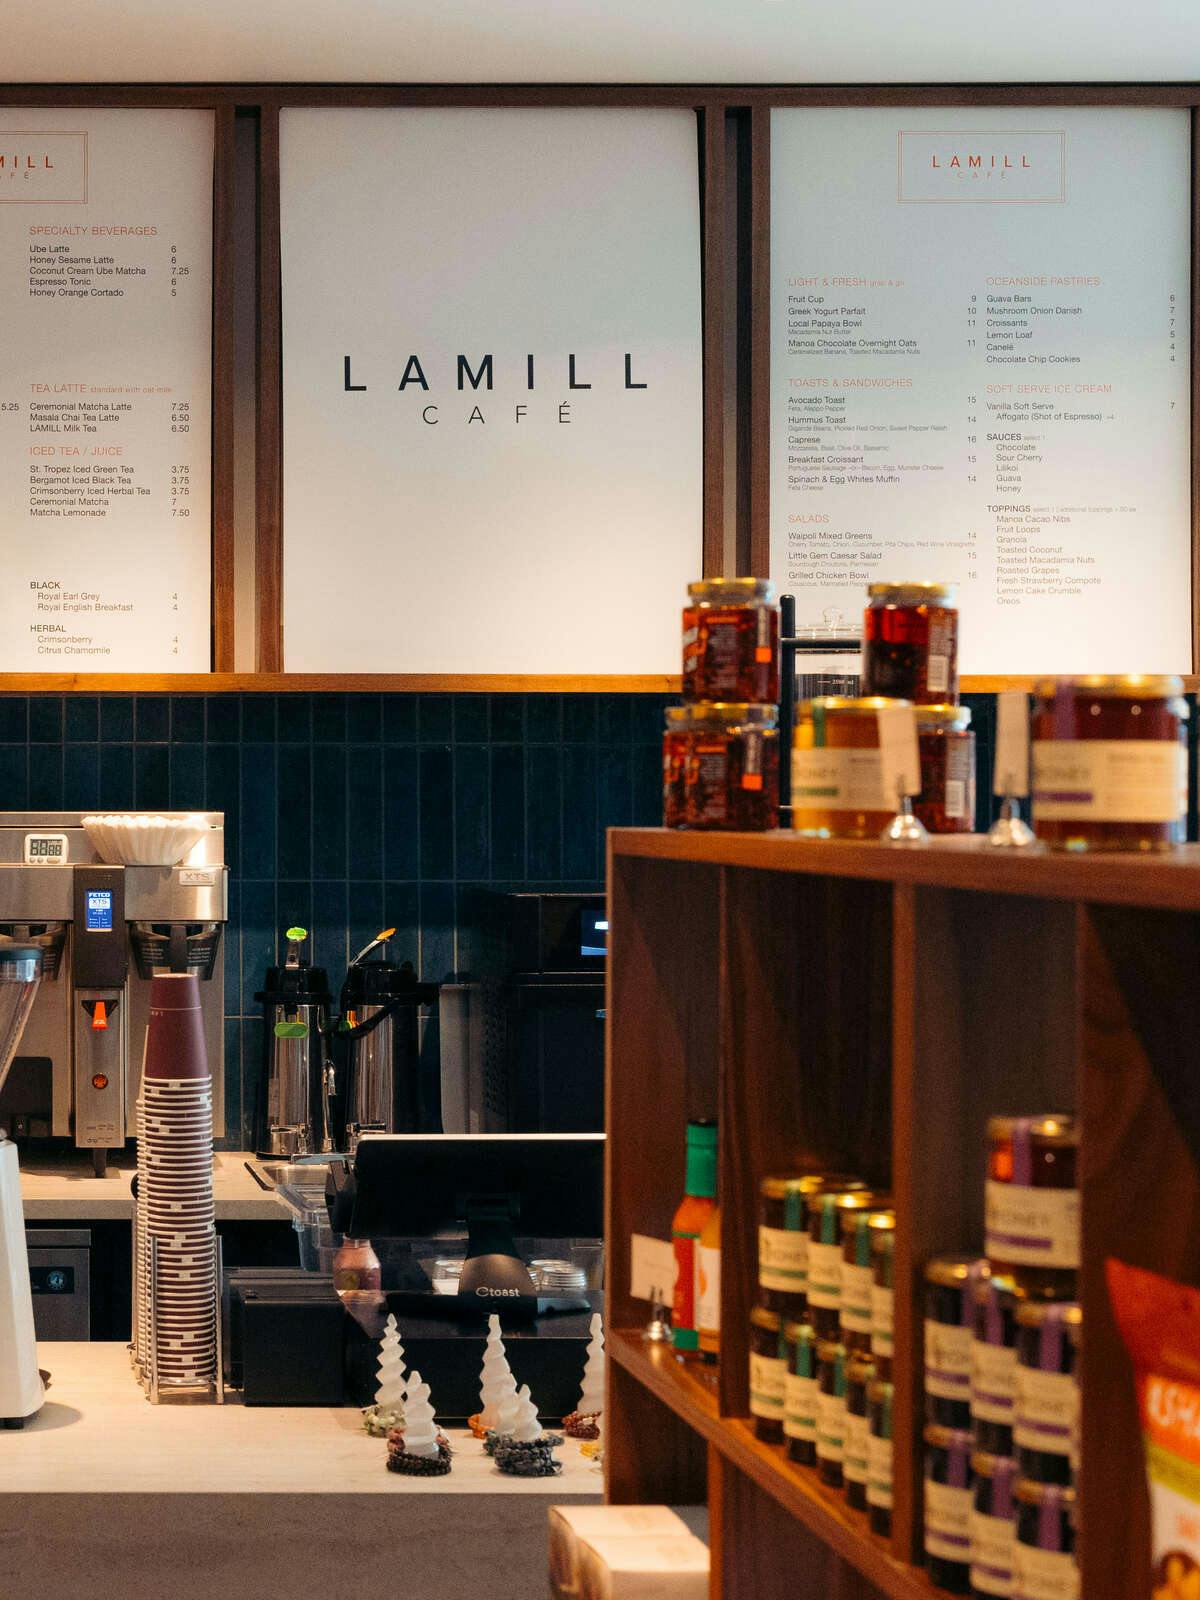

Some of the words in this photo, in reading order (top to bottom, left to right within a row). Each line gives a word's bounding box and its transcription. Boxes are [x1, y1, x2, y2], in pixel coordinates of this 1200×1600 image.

[932, 155, 1031, 168] LAMILL
[30, 226, 88, 235] SPECIALTY
[92, 226, 158, 236] BEVERAGES
[30, 245, 47, 253] Ube
[49, 245, 70, 253] Latte
[171, 245, 177, 253] 6
[30, 256, 56, 266] Honey
[58, 256, 91, 264] Sesame
[94, 256, 114, 264] Latte
[30, 267, 65, 275] Coconut
[67, 267, 94, 275] Cream
[96, 267, 113, 275] Ube
[116, 267, 146, 275] Matcha
[172, 267, 190, 275] 7.25
[30, 277, 68, 287] Espresso
[69, 278, 91, 286] Tonic
[171, 278, 177, 286] 6
[986, 277, 1047, 286] OCEANSIDE
[1051, 277, 1100, 286] PASTRIES
[30, 288, 56, 298] Honey
[58, 288, 89, 298] Orange
[91, 289, 124, 297] Cortado
[172, 289, 177, 297] 5
[788, 296, 806, 304] Fruit
[807, 296, 824, 304] Cup
[788, 307, 812, 315] Greek
[813, 308, 839, 317] Yogurt
[841, 307, 866, 315] Parfait
[811, 320, 841, 329] Papaya
[986, 319, 1028, 327] Croissants
[986, 331, 1013, 339] Lemon
[1016, 331, 1033, 339] Loaf
[1170, 330, 1176, 338] 5
[344, 353, 647, 391] LAMILL
[30, 384, 52, 393] TEA
[54, 384, 88, 393] LATTE
[788, 396, 823, 405] Avocado
[824, 396, 845, 404] Toast
[968, 396, 976, 404] 15
[1, 403, 19, 411] 5.25
[30, 402, 76, 411] Ceremonial
[78, 403, 109, 411] Matcha
[111, 403, 132, 411] Latte
[172, 403, 190, 411] 7.25
[986, 402, 1012, 411] Vanilla
[1013, 402, 1030, 410] Soft
[1032, 402, 1054, 410] Serve
[422, 401, 571, 424] CAFÉ
[30, 413, 59, 421] Masala
[61, 413, 80, 422] Chai
[82, 413, 97, 422] Tea
[99, 414, 120, 422] Latte
[172, 414, 190, 422] 6.50
[30, 424, 61, 432] LAMILL
[64, 424, 81, 432] Milk
[82, 424, 97, 432] Tea
[788, 436, 821, 445] Caprese
[986, 433, 1022, 441] SAUCES
[996, 444, 1036, 452] Chocolate
[788, 456, 825, 464] Breakfast
[826, 456, 864, 464] Croissant
[996, 474, 1022, 482] Guava
[996, 484, 1022, 494] Honey
[987, 505, 1031, 513] TOPPINGS
[788, 515, 830, 523] SALADS
[788, 552, 808, 560] Little
[809, 552, 829, 560] Gem
[860, 552, 882, 560] Salad
[30, 581, 61, 590] BLACK
[30, 624, 66, 632] HERBAL
[185, 872, 209, 881] XTS
